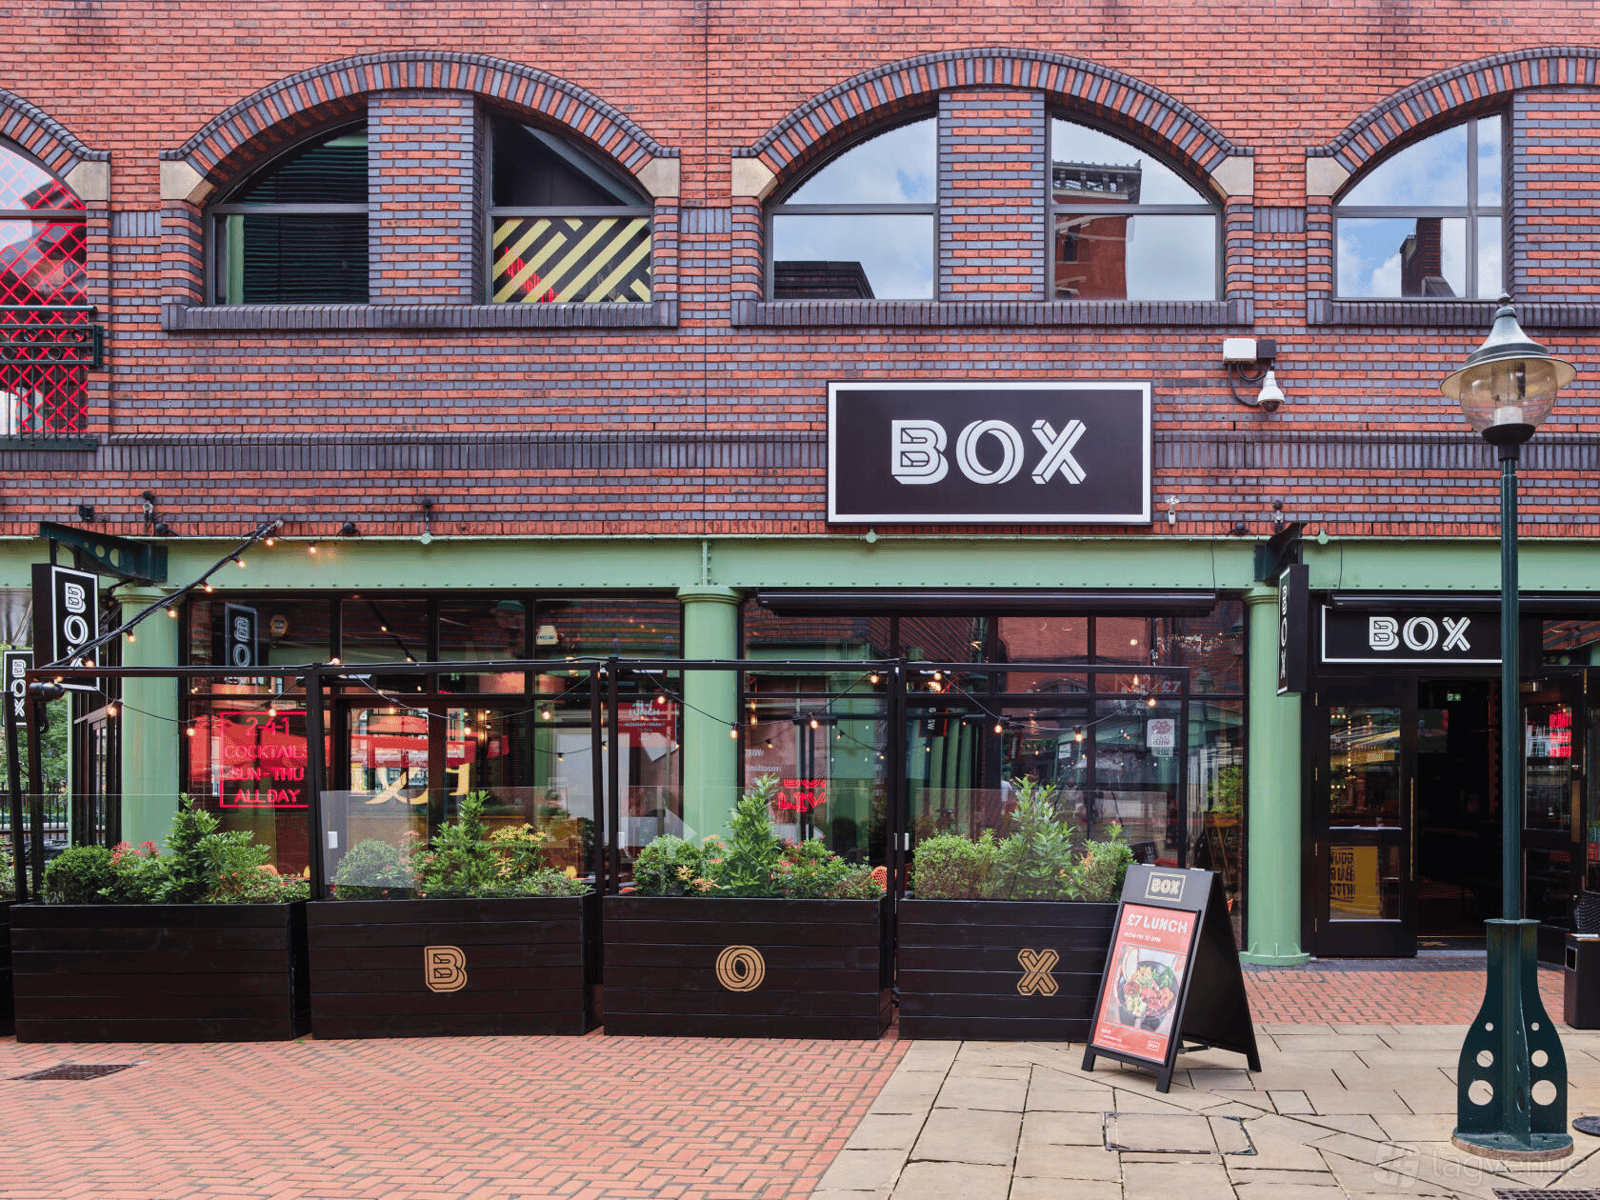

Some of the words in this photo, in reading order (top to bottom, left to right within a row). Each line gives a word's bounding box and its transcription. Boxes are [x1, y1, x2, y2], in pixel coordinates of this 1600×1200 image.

[892, 420, 1087, 485] BOX
[1368, 616, 1471, 651] BOX
[246, 716, 289, 736] 2-4-1
[271, 767, 304, 781] THU
[233, 788, 266, 803] ALL
[267, 788, 301, 803] DAY
[1151, 877, 1180, 895] BOX
[1127, 913, 1143, 927] £7
[1143, 915, 1188, 934] LUNCH
[425, 946, 467, 992] B
[716, 946, 765, 992] O
[1017, 949, 1059, 996] X
